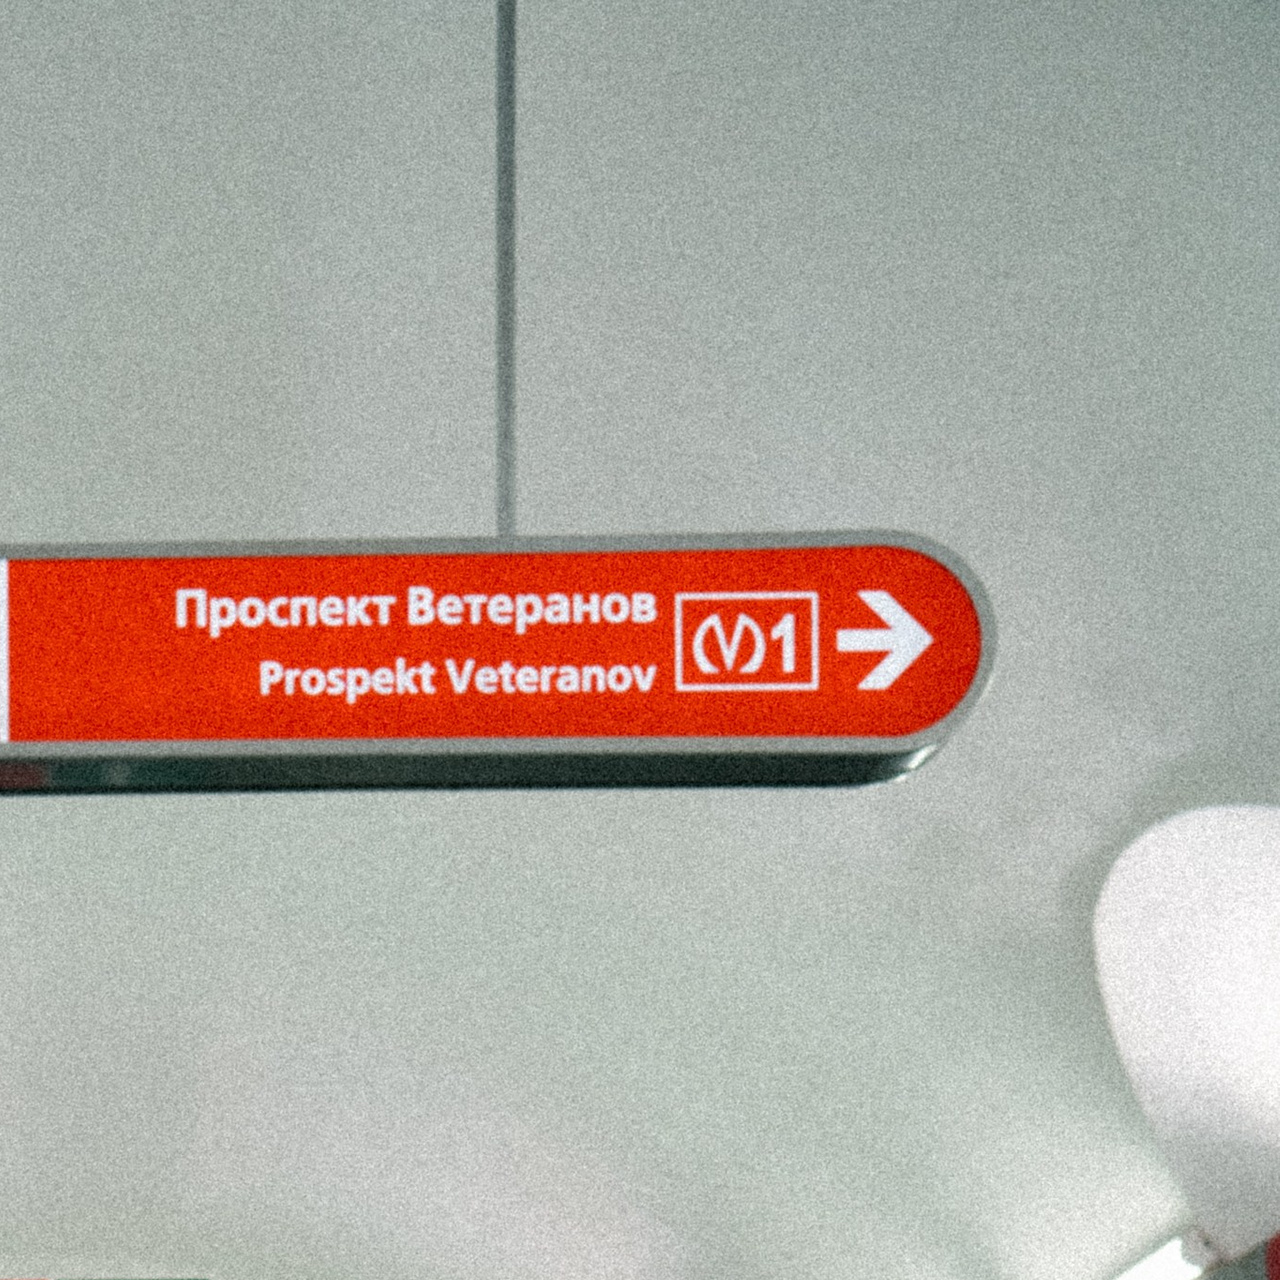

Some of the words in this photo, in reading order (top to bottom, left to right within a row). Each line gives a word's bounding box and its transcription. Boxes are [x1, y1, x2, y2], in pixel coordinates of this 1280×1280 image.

[174, 587, 398, 640] Проспект
[406, 584, 658, 636] Ветеранов
[258, 656, 437, 706] Prospekt
[444, 658, 658, 695] Veteranov
